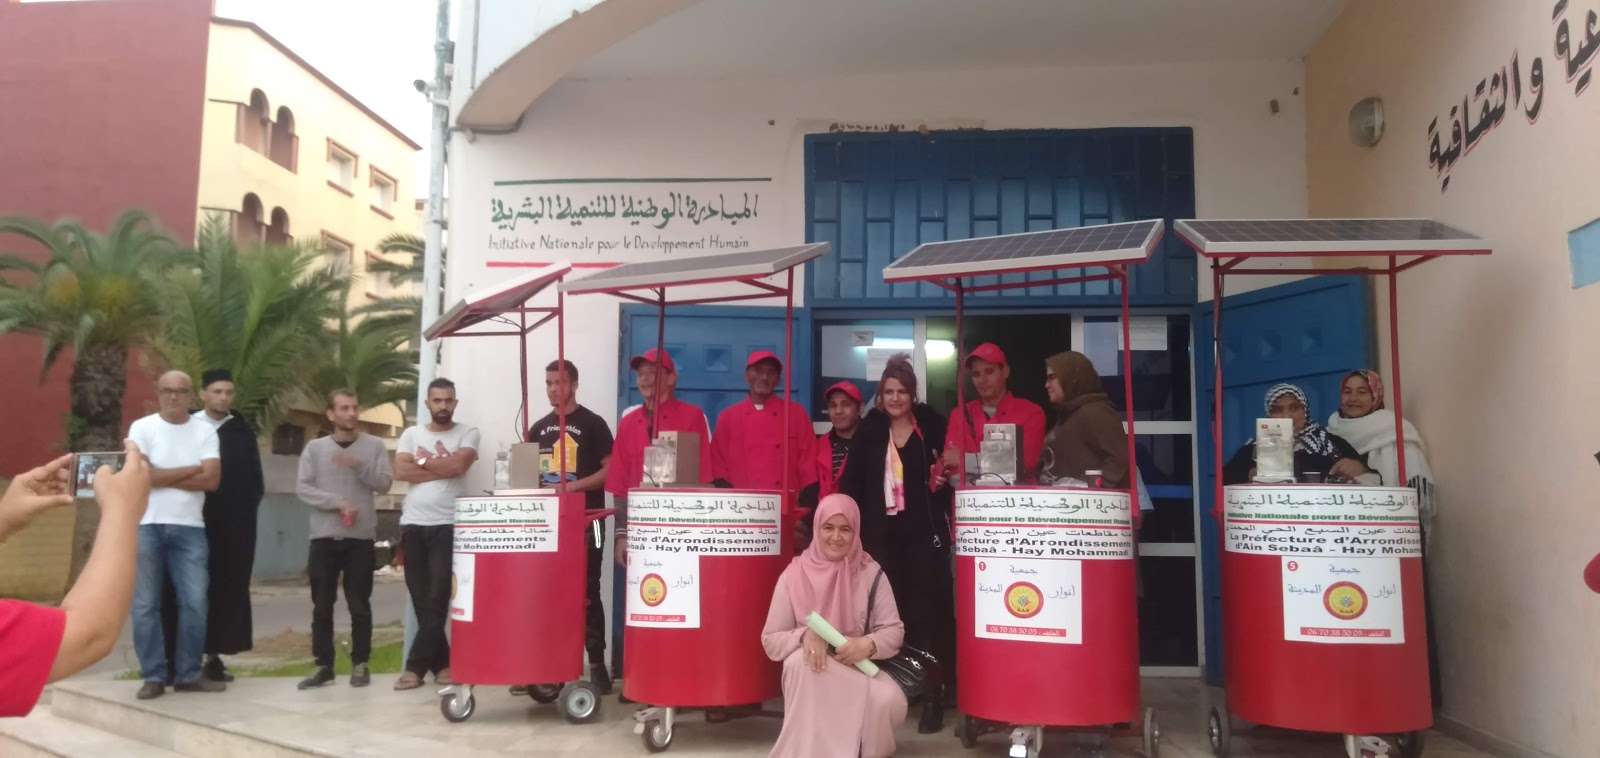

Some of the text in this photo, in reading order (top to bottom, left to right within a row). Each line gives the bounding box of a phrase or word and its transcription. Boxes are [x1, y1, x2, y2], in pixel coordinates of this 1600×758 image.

[1428, 48, 1544, 194] والثقافية
[491, 192, 758, 231] المبادرة الوطنية للتنمية البشرية
[488, 235, 536, 250] Initiative
[540, 235, 594, 249] Nationale
[598, 240, 620, 254] pour
[624, 236, 631, 249] le
[710, 235, 749, 249] Humain
[662, 499, 725, 515] الوطنية
[727, 500, 776, 514] المبادرة
[967, 496, 1016, 511] للتنمية
[1020, 497, 1089, 514] الوطنية
[1227, 494, 1273, 510] البشرية
[1276, 494, 1345, 509] للتنمية
[490, 502, 545, 515] المبادرة
[1028, 516, 1112, 524] Développement
[637, 527, 662, 535] السبع
[960, 527, 979, 536] الحي
[984, 528, 1019, 536] السبع
[1066, 529, 1118, 537] مقاطعات
[1262, 525, 1296, 534] الحي
[1304, 526, 1349, 536] السبع
[1358, 528, 1386, 536] عين
[651, 536, 776, 545] d'Arrondissements
[1242, 533, 1327, 544] Préfecture
[655, 544, 681, 553] Hay
[686, 545, 769, 553] Mohammadi
[962, 545, 997, 553] Sebaâ
[1012, 547, 1044, 557] Hay
[1051, 547, 1129, 556] Mohammadi
[1235, 542, 1262, 551] d'Ain
[1268, 543, 1323, 553] Sebaâ
[1342, 546, 1376, 555] Hay
[643, 559, 663, 568] جمعية
[1009, 564, 1038, 575] جمعية
[1329, 564, 1361, 575] جمعية
[671, 575, 694, 588] أنوار
[978, 583, 1003, 594] المدينة
[1288, 584, 1321, 595] المدينة
